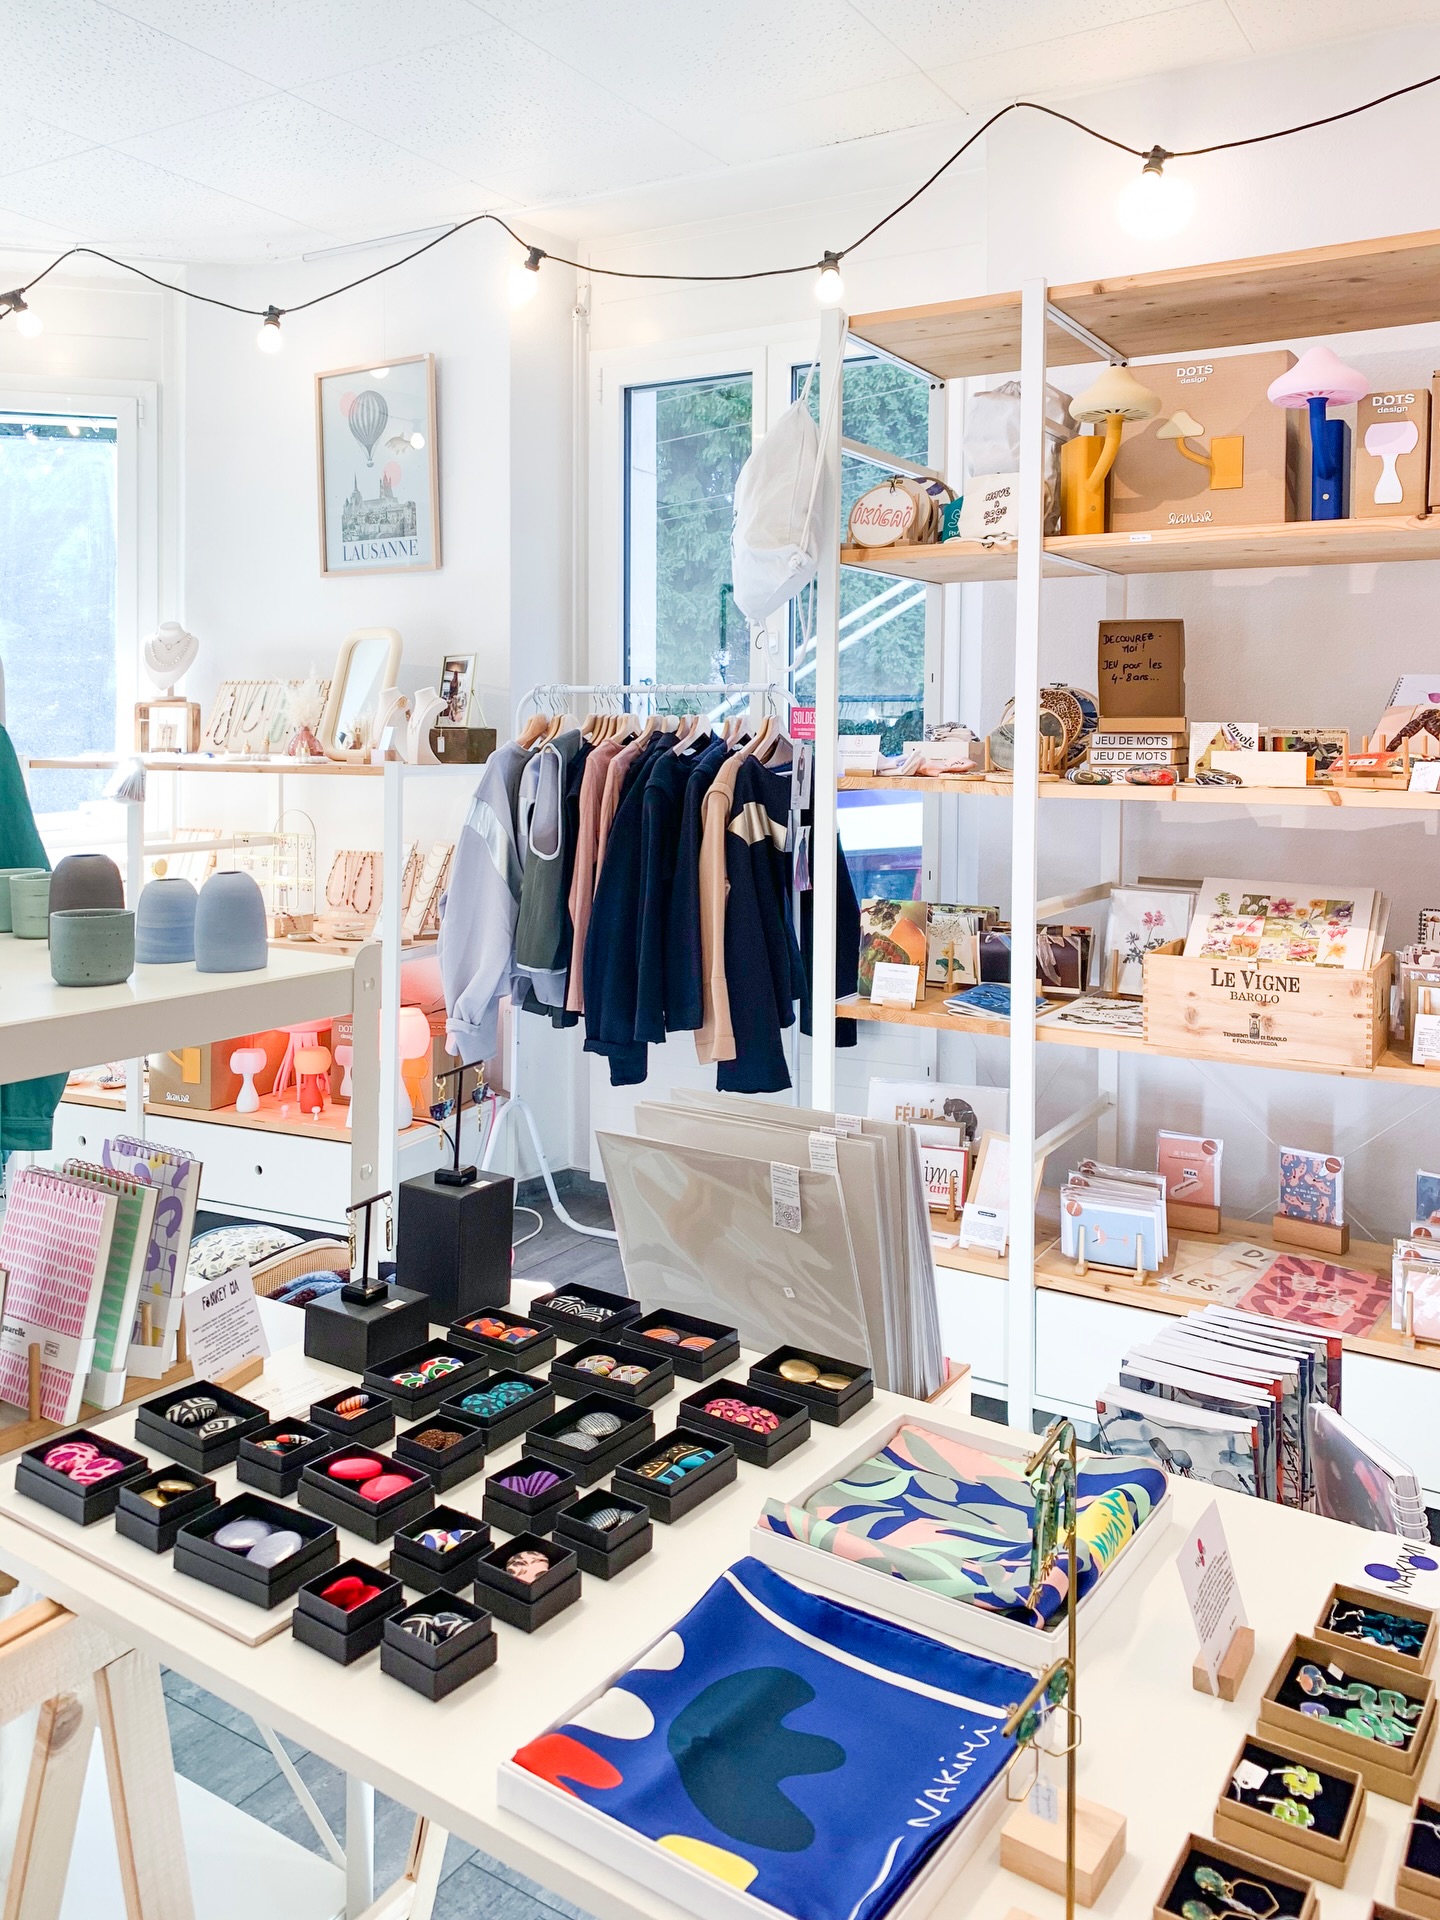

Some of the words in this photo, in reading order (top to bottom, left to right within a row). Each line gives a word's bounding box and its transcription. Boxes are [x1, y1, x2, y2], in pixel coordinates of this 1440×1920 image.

[1176, 365, 1214, 377] DOTS
[1180, 376, 1207, 384] design
[1372, 393, 1415, 406] DOTS
[1377, 405, 1408, 413] design
[985, 487, 1011, 501] HAVE
[343, 539, 419, 561] LAUSANNE
[1102, 659, 1119, 670] JEU
[1122, 662, 1142, 675] pour
[1148, 657, 1163, 669] les
[1095, 736, 1116, 745] JEU
[1118, 736, 1134, 745] DE
[1136, 736, 1168, 746] MOTS
[1094, 752, 1114, 761] JEU
[1117, 752, 1132, 761] DE
[1135, 752, 1167, 761] MOTS
[1210, 967, 1236, 988] LE
[1240, 969, 1300, 993] VIGNE
[1229, 991, 1280, 1004] BAROLO
